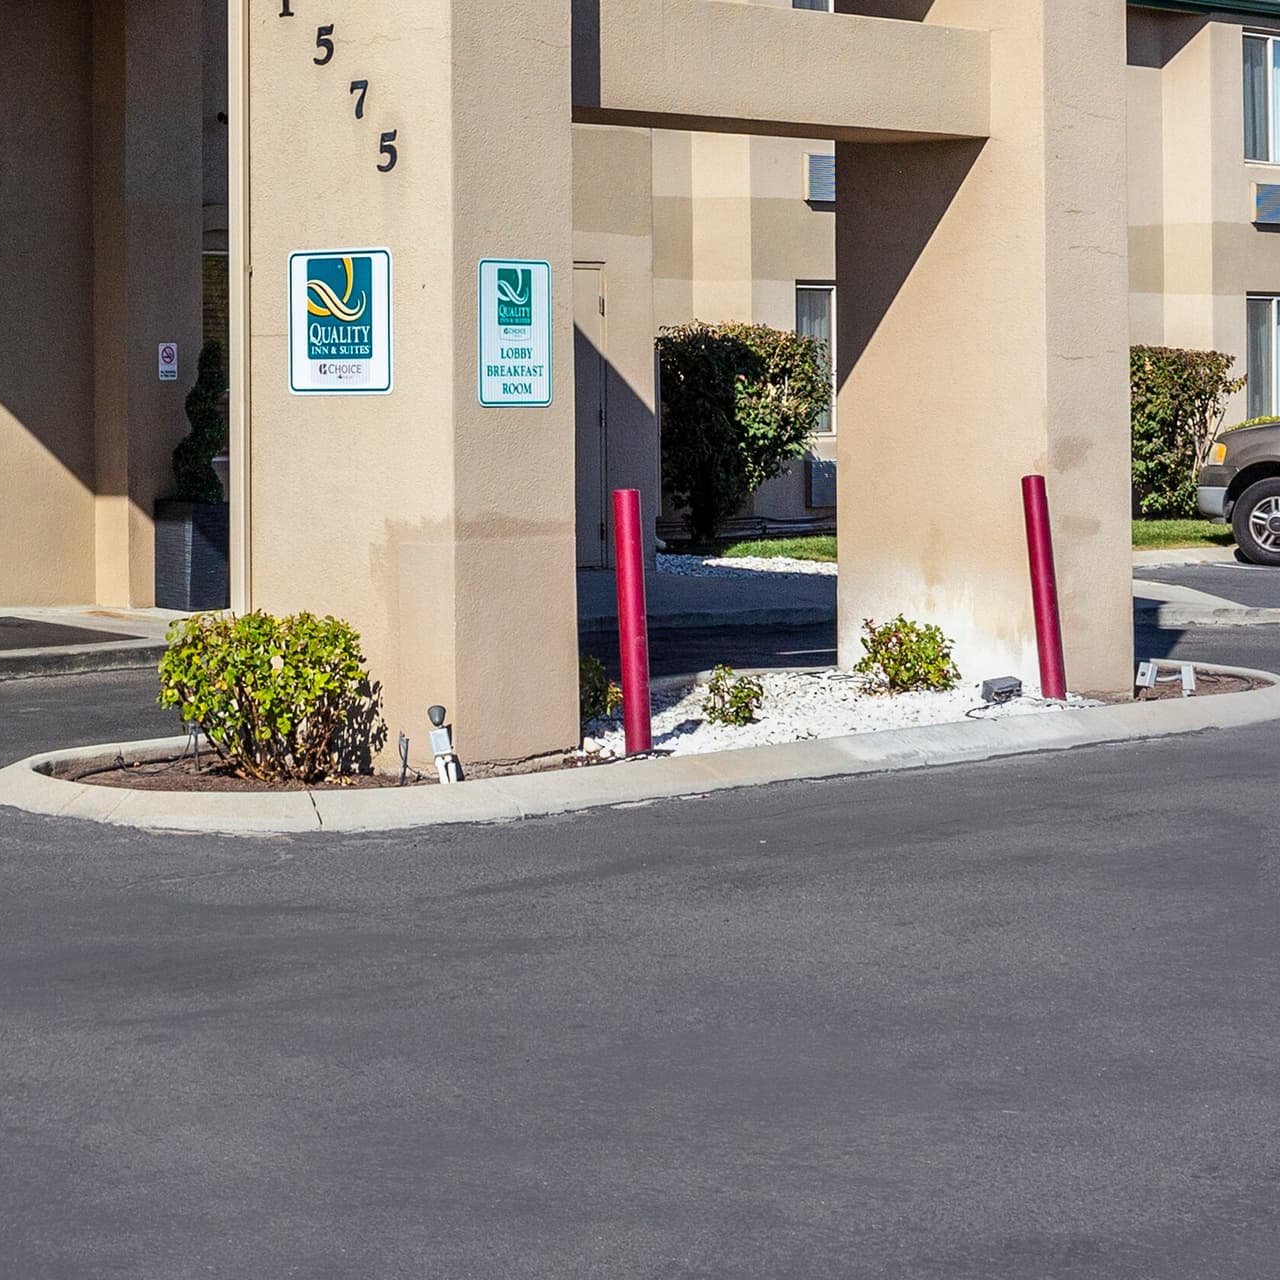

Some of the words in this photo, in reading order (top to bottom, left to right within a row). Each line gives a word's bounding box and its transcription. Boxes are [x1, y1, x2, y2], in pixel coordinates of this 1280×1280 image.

[309, 322, 370, 346] QUALITY
[311, 345, 329, 355] INN
[330, 346, 337, 355] &
[339, 345, 370, 355] SUITES
[500, 347, 533, 360] LOBBY
[327, 363, 362, 375] CHOICE
[486, 364, 545, 377] BREAKFAST
[502, 382, 532, 394] ROOM
